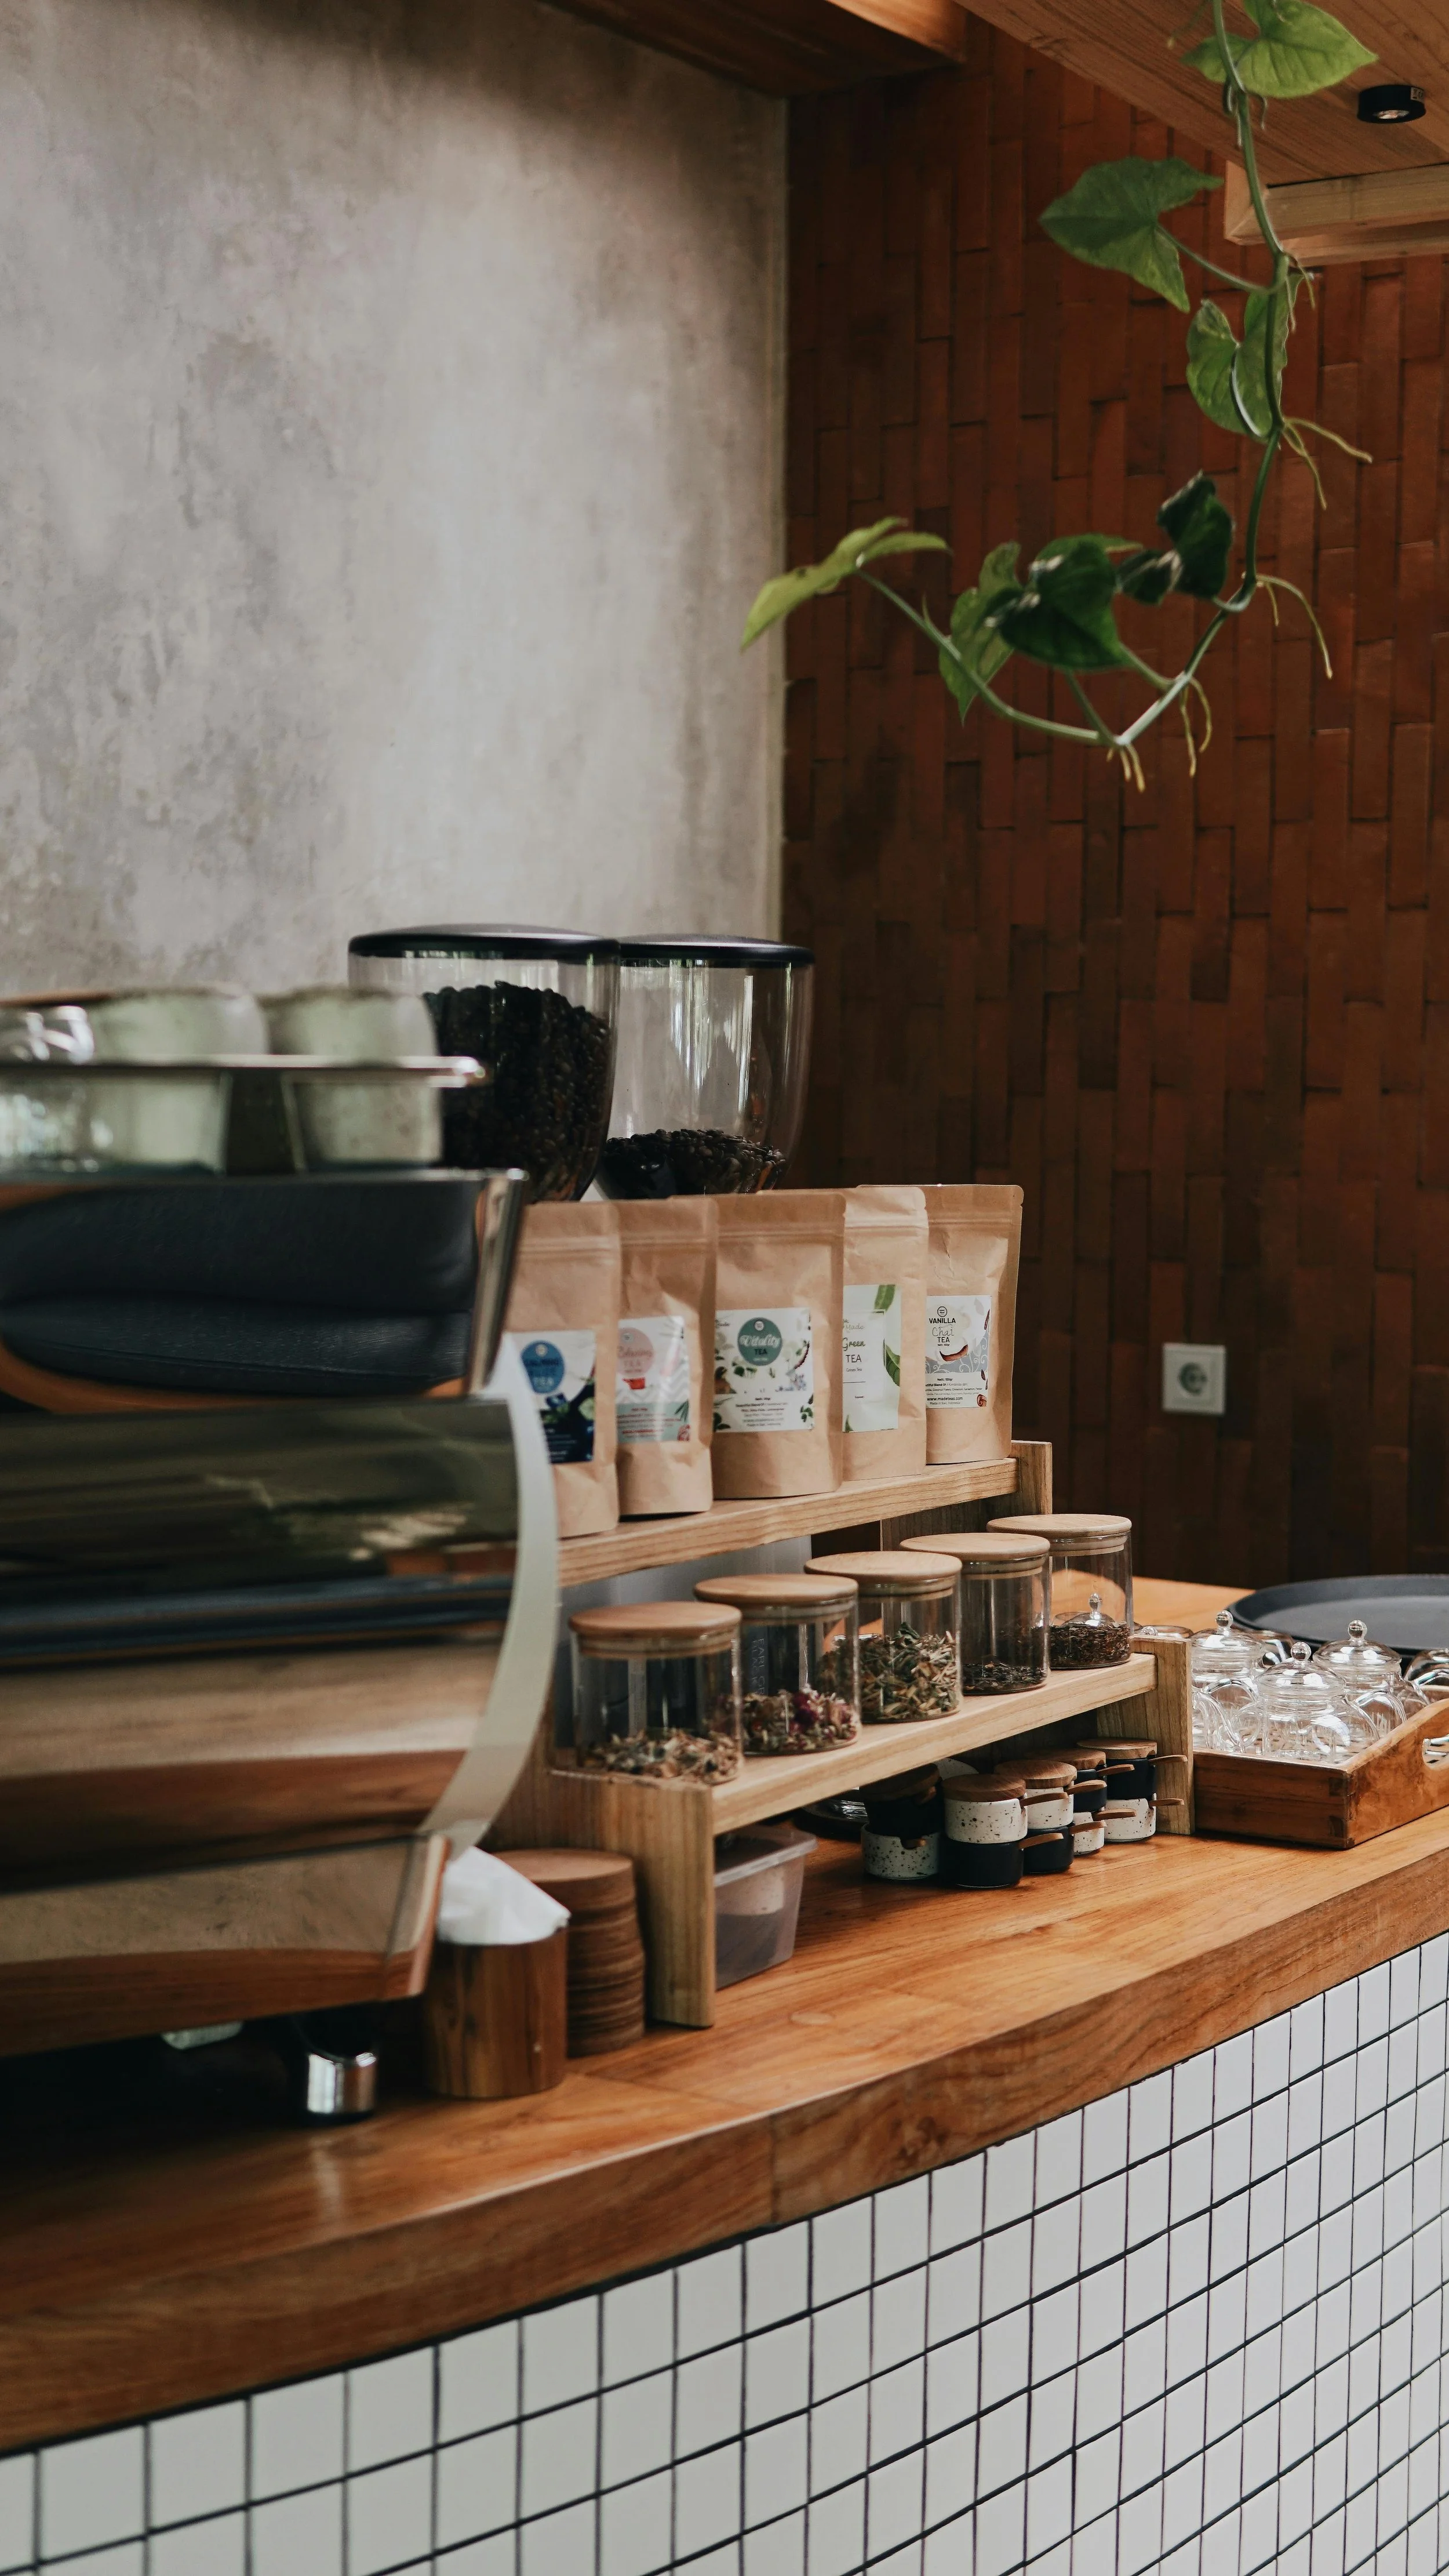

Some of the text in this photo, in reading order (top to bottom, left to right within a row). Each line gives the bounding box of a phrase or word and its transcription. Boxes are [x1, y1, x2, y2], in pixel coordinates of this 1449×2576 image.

[932, 1327, 955, 1337] Chai
[739, 1334, 781, 1348] Vitality
[842, 1337, 866, 1351] Green
[624, 1359, 642, 1367] TEA
[846, 1354, 862, 1363] TEA
[532, 1376, 555, 1387] TEA
